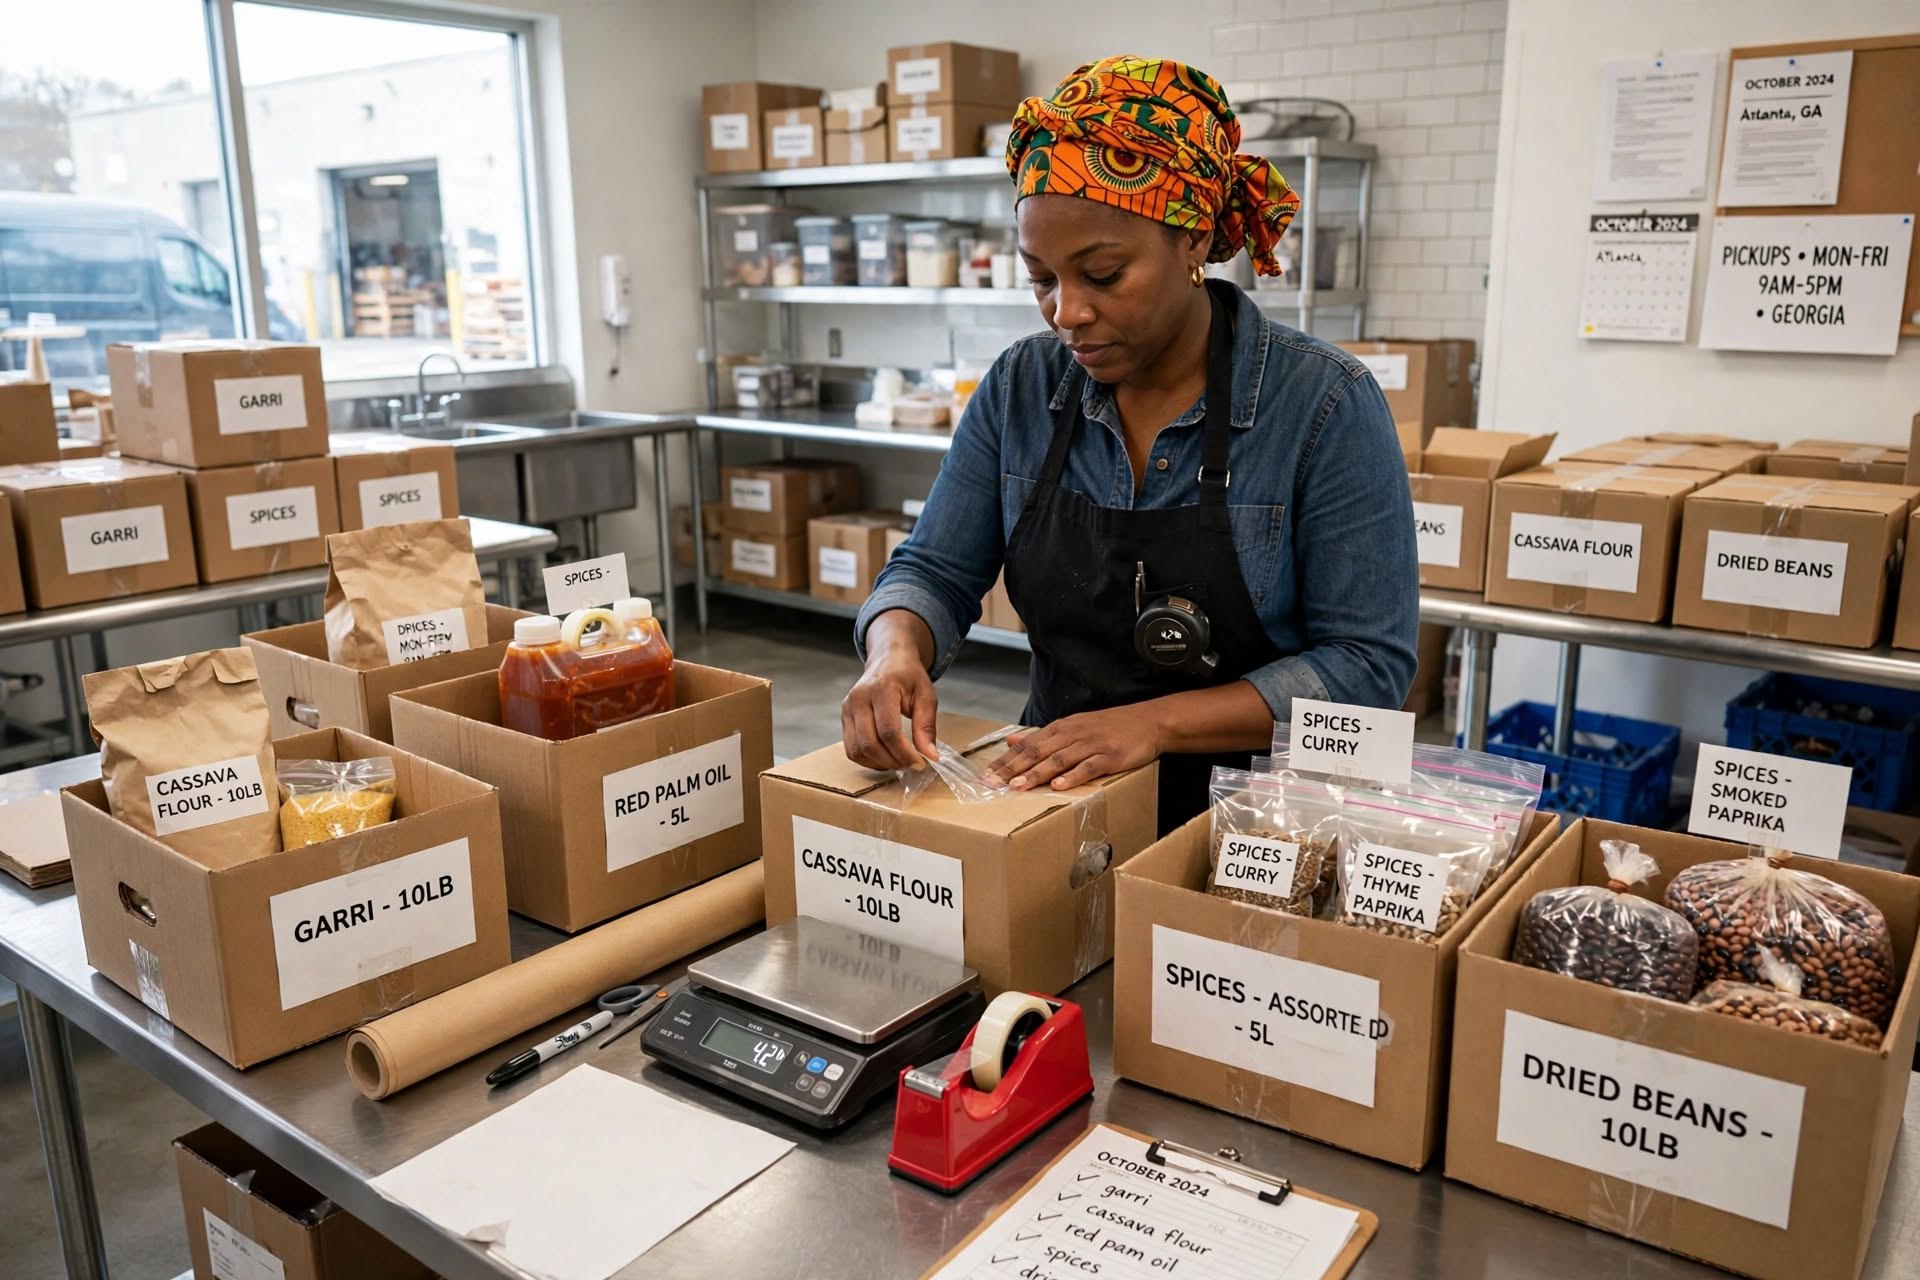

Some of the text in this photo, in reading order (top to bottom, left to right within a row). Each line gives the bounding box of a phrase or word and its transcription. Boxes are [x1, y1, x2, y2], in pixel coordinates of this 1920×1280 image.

[1744, 73, 1835, 90] OCTOBER 2024
[1800, 103, 1823, 119] GA
[1722, 245, 1792, 267] PICKUPS
[1812, 245, 1889, 267] MON-FRI
[1758, 274, 1843, 296] 9AM-5PM
[1771, 303, 1845, 326] GEORGIA
[239, 392, 283, 409] GARRI
[379, 489, 422, 508] SPICES
[249, 504, 297, 524] SPICES
[90, 526, 139, 546] GARRI
[1514, 533, 1633, 559] CASSAVA FLOUR
[564, 567, 603, 587] SPICES
[1717, 552, 1833, 579] DRIED BEANS
[1302, 711, 1361, 734] SPICES
[1301, 734, 1359, 756] CURRY
[156, 767, 239, 797] CASSAVA
[1713, 759, 1779, 785] SPICES
[157, 794, 214, 819] FLOUR
[226, 782, 263, 803] 10LB
[615, 763, 732, 818] RED PALM OIL
[1710, 782, 1788, 809] SMOKED
[670, 805, 690, 826] 5L
[1707, 803, 1785, 833] PAPRIKA
[1227, 841, 1282, 864] SPICES
[801, 848, 954, 909] CASSAVA FLOUR
[1224, 862, 1279, 885] CURRY
[1363, 853, 1423, 879] SPICES
[1362, 873, 1421, 901] THYME
[294, 899, 374, 943] GARRI
[398, 875, 454, 911] 10LB
[856, 894, 901, 923] 10LB
[1353, 894, 1425, 925] PAPRIKA
[1166, 962, 1246, 1004] SPICES
[1249, 1020, 1274, 1047] 5L
[1523, 1053, 1621, 1102] DRIED
[1632, 1084, 1748, 1139] BEANS
[1601, 1117, 1679, 1160] 10LB
[1097, 1151, 1167, 1184] OCTOBER
[1168, 1177, 1210, 1198] 2024
[1099, 1185, 1153, 1206] garri
[1086, 1204, 1212, 1255] cassava flour
[1043, 1246, 1101, 1274] spices
[1065, 1223, 1179, 1273] red pam oil
